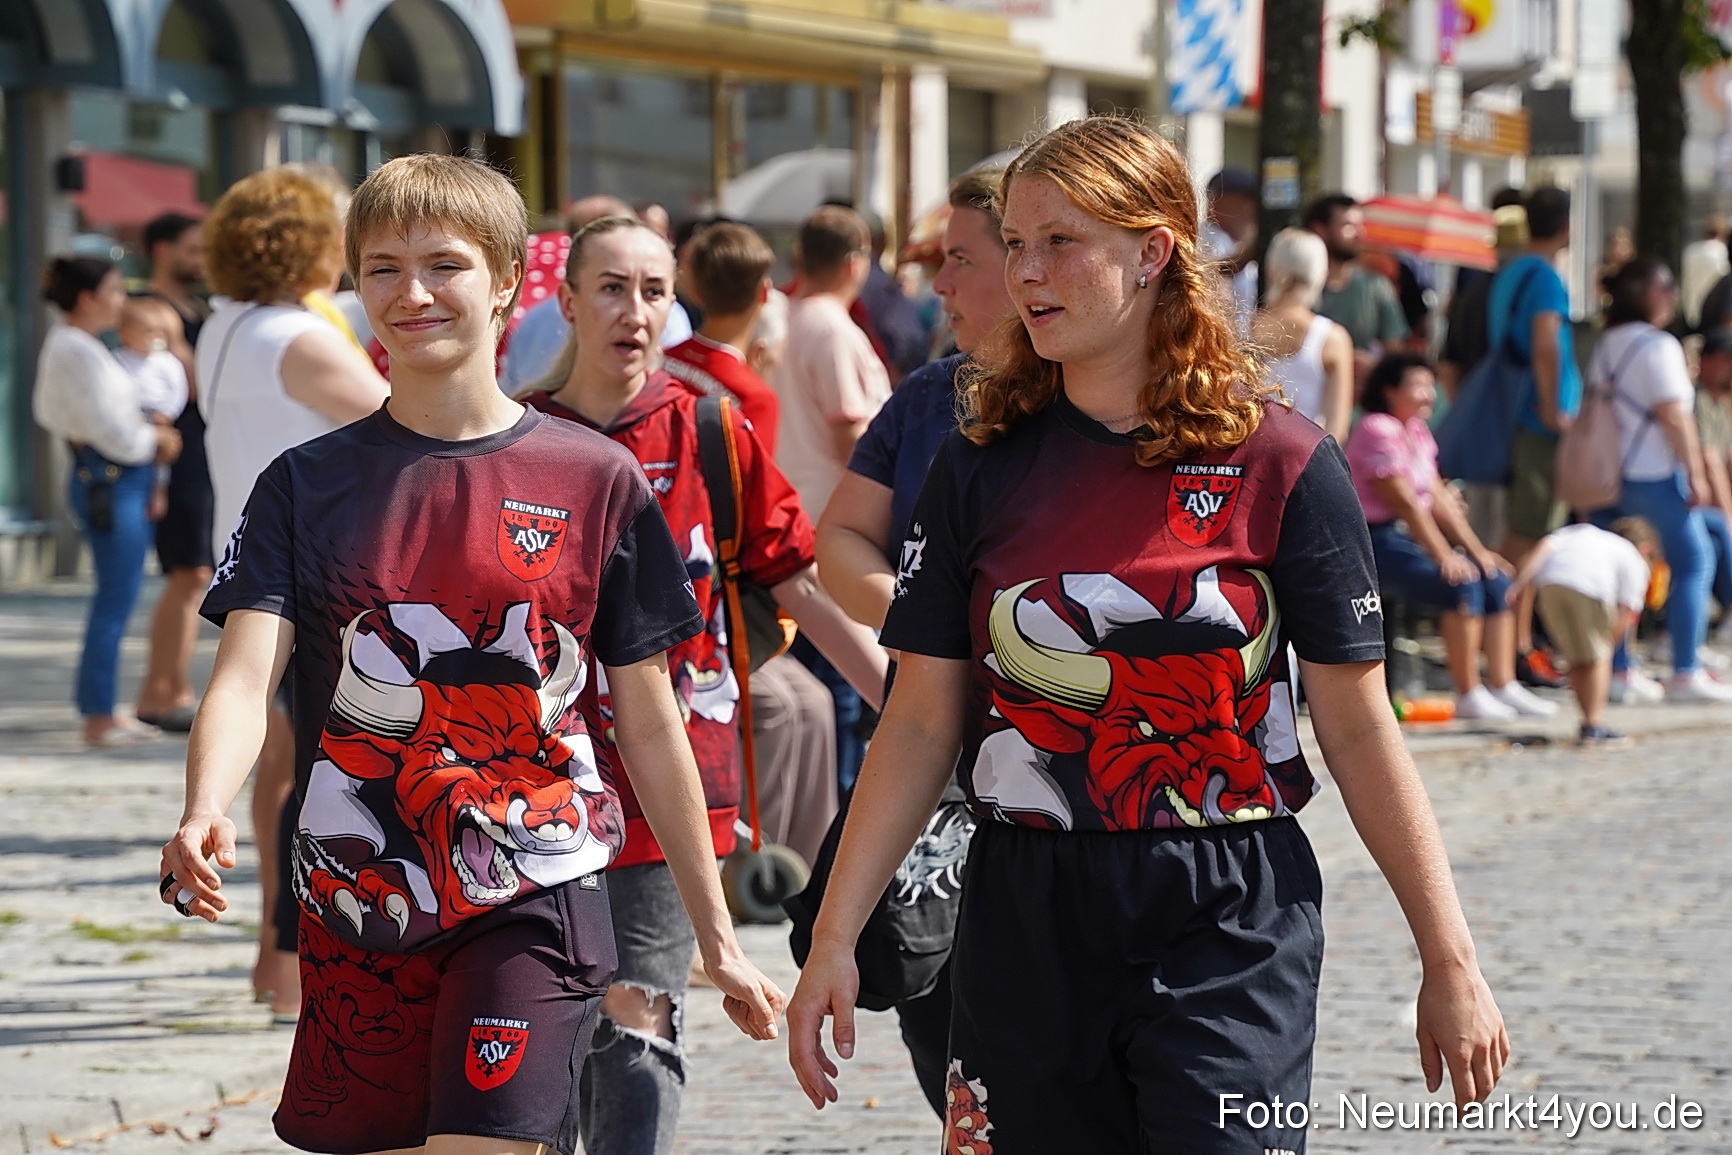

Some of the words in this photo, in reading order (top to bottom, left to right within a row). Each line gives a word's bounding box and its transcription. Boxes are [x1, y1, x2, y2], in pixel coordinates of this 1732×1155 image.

[1175, 464, 1242, 476] NEUMARKT
[503, 500, 568, 519] NEUMARKT
[1184, 490, 1223, 518] ASV
[513, 528, 550, 553] ASV
[472, 1017, 530, 1030] NEUMARKT
[477, 1040, 512, 1064] ASV
